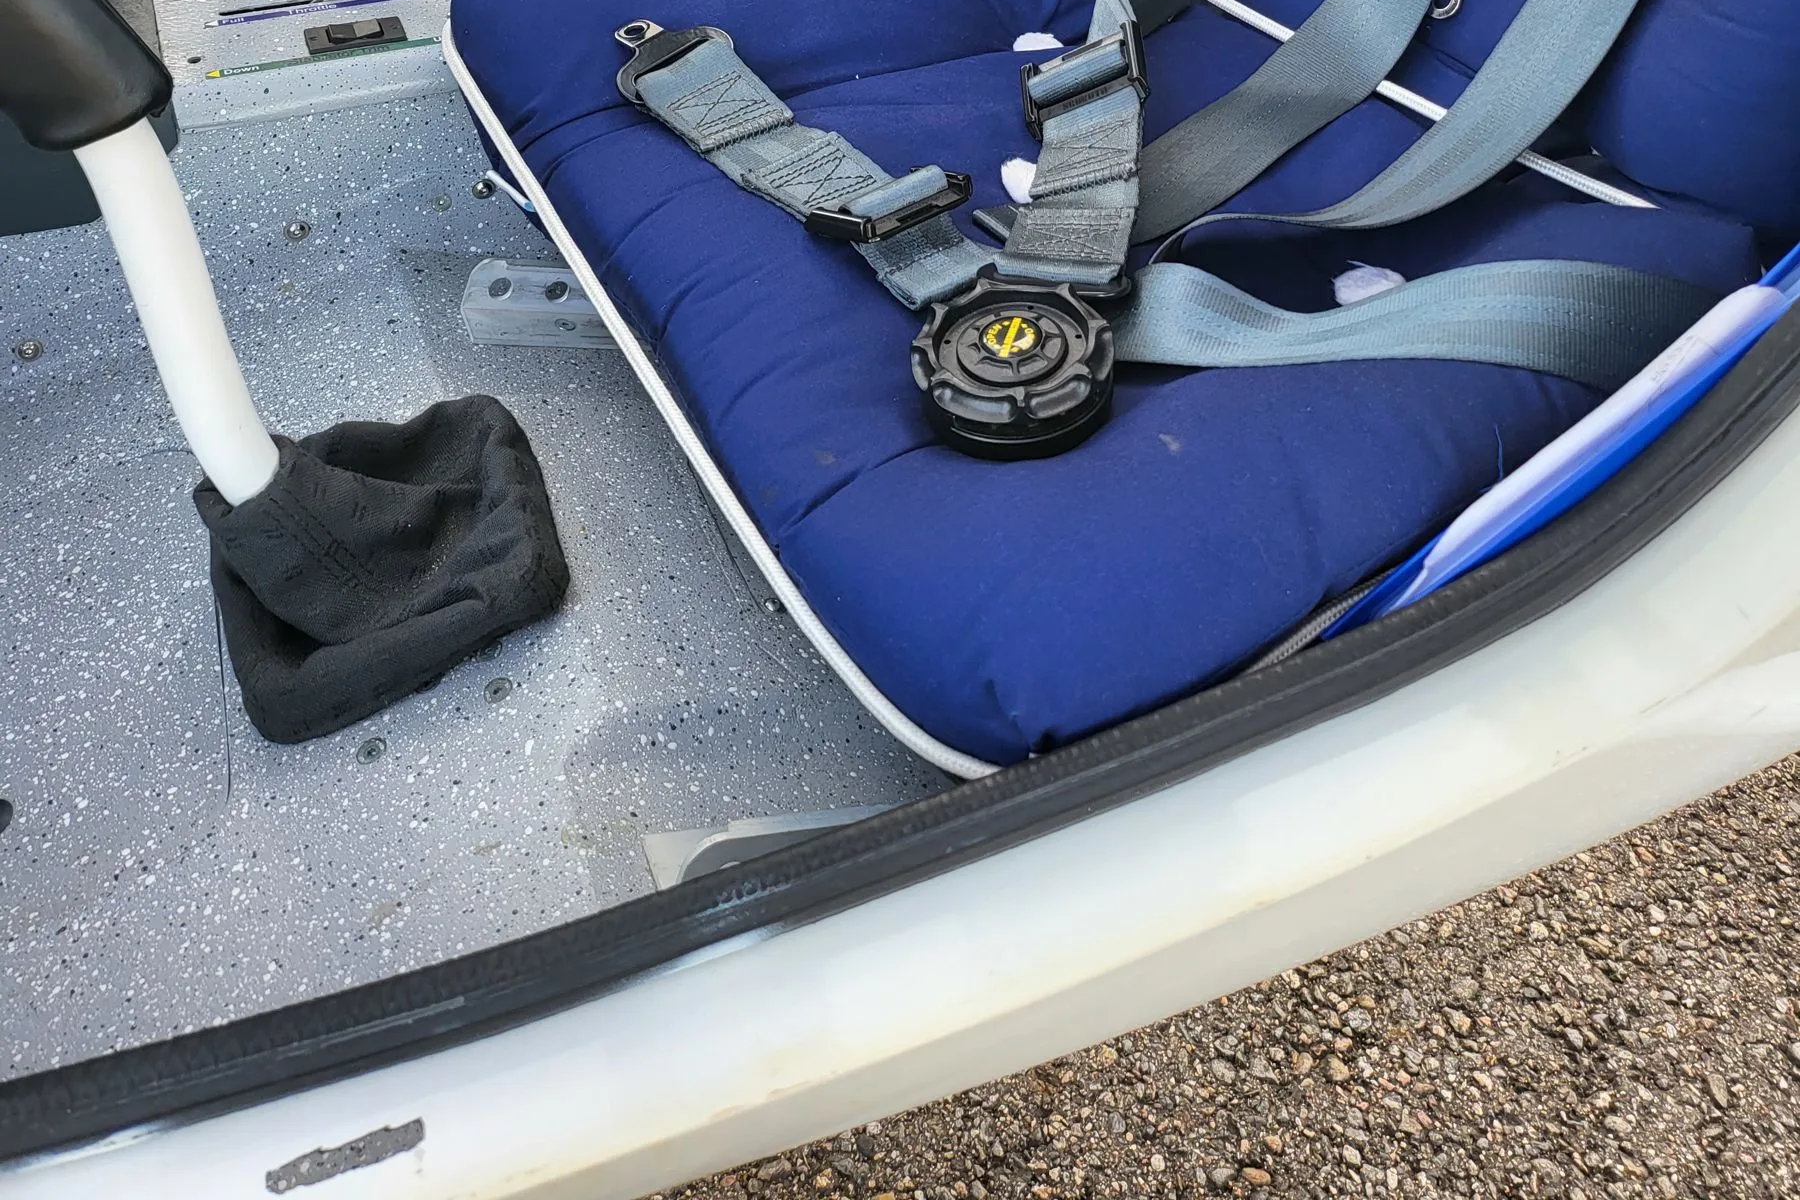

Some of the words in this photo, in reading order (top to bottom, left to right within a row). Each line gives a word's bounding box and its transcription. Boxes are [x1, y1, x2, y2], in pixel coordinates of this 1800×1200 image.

[222, 17, 245, 25] Full
[287, 3, 338, 15] Throttle
[223, 64, 260, 75] Down
[986, 323, 1003, 345] OPEN
